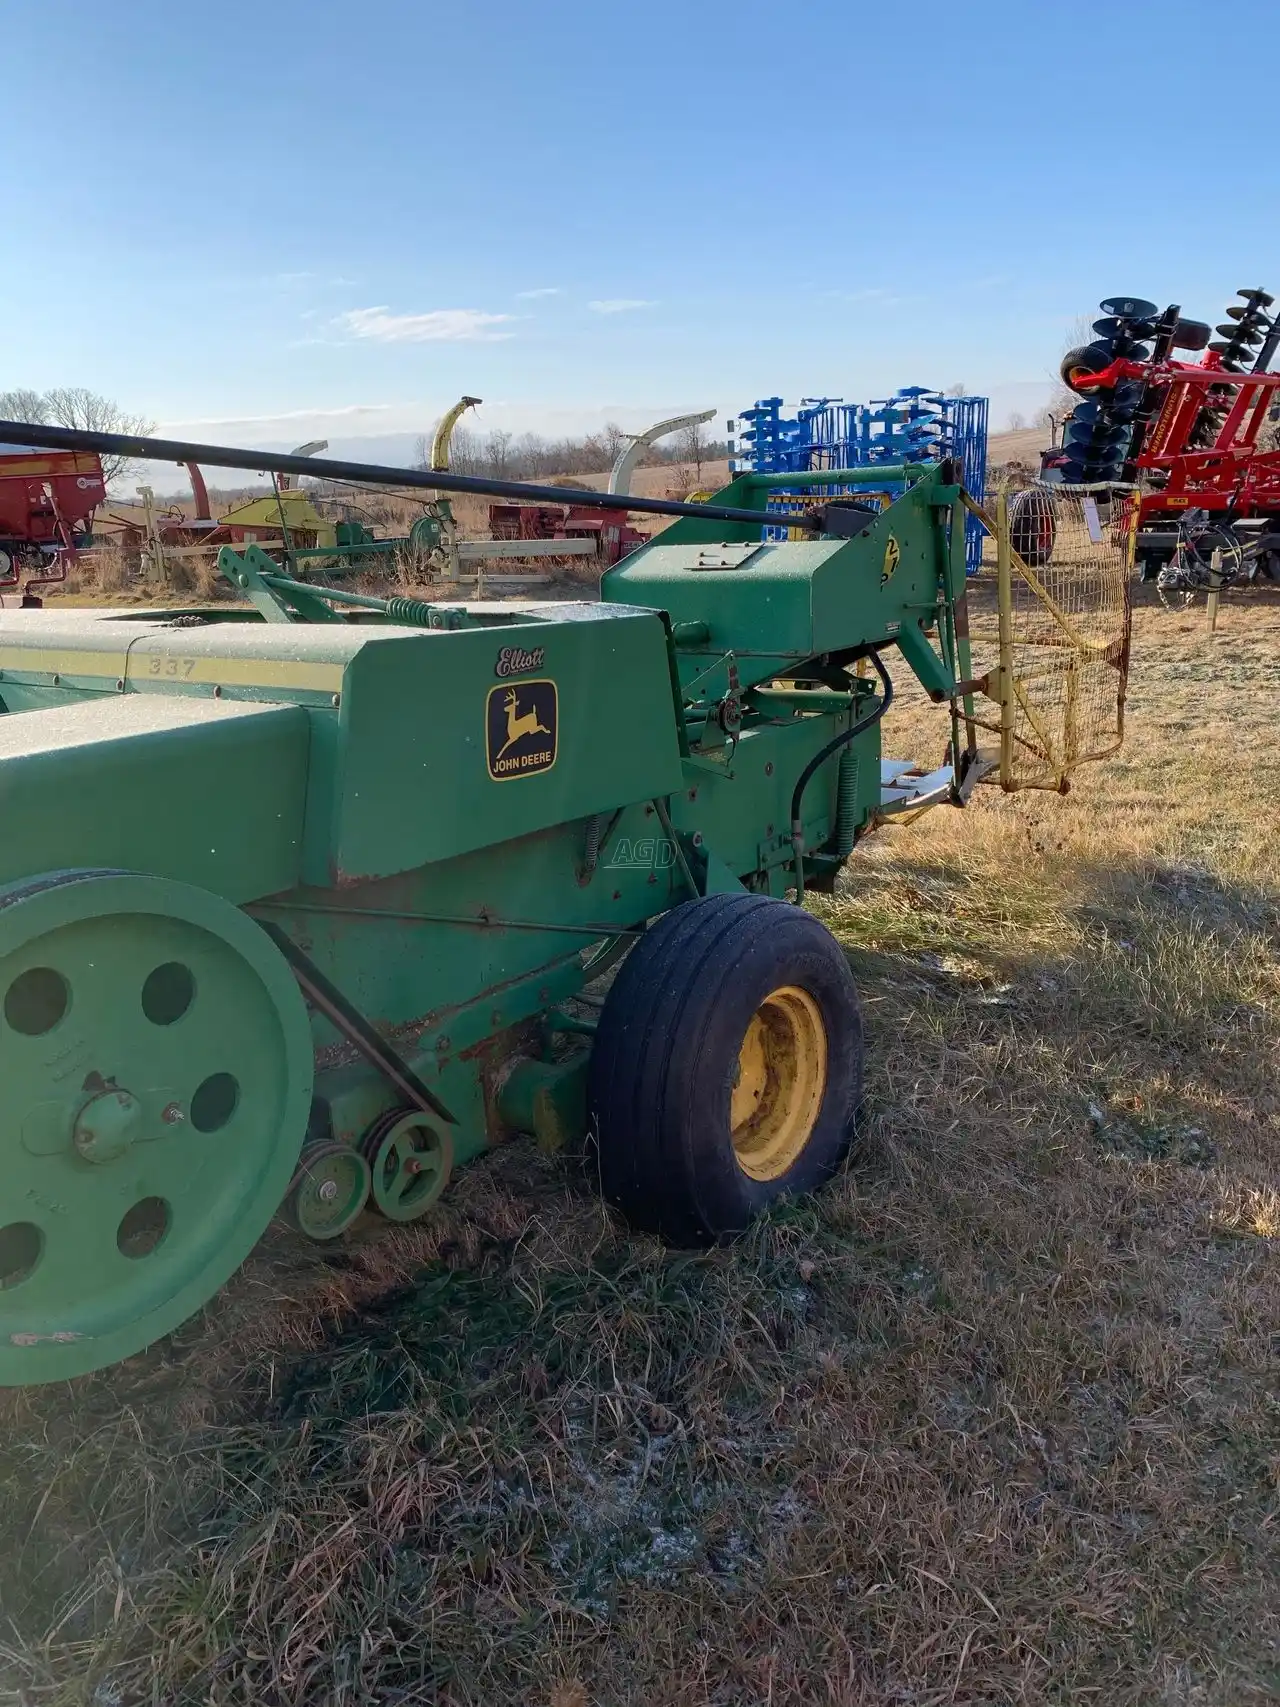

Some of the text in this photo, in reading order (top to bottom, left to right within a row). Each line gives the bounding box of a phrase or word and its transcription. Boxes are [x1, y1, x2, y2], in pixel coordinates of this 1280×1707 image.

[148, 658, 196, 677] 337
[496, 647, 545, 677] Elliott
[493, 751, 552, 773] JOHN DEERE
